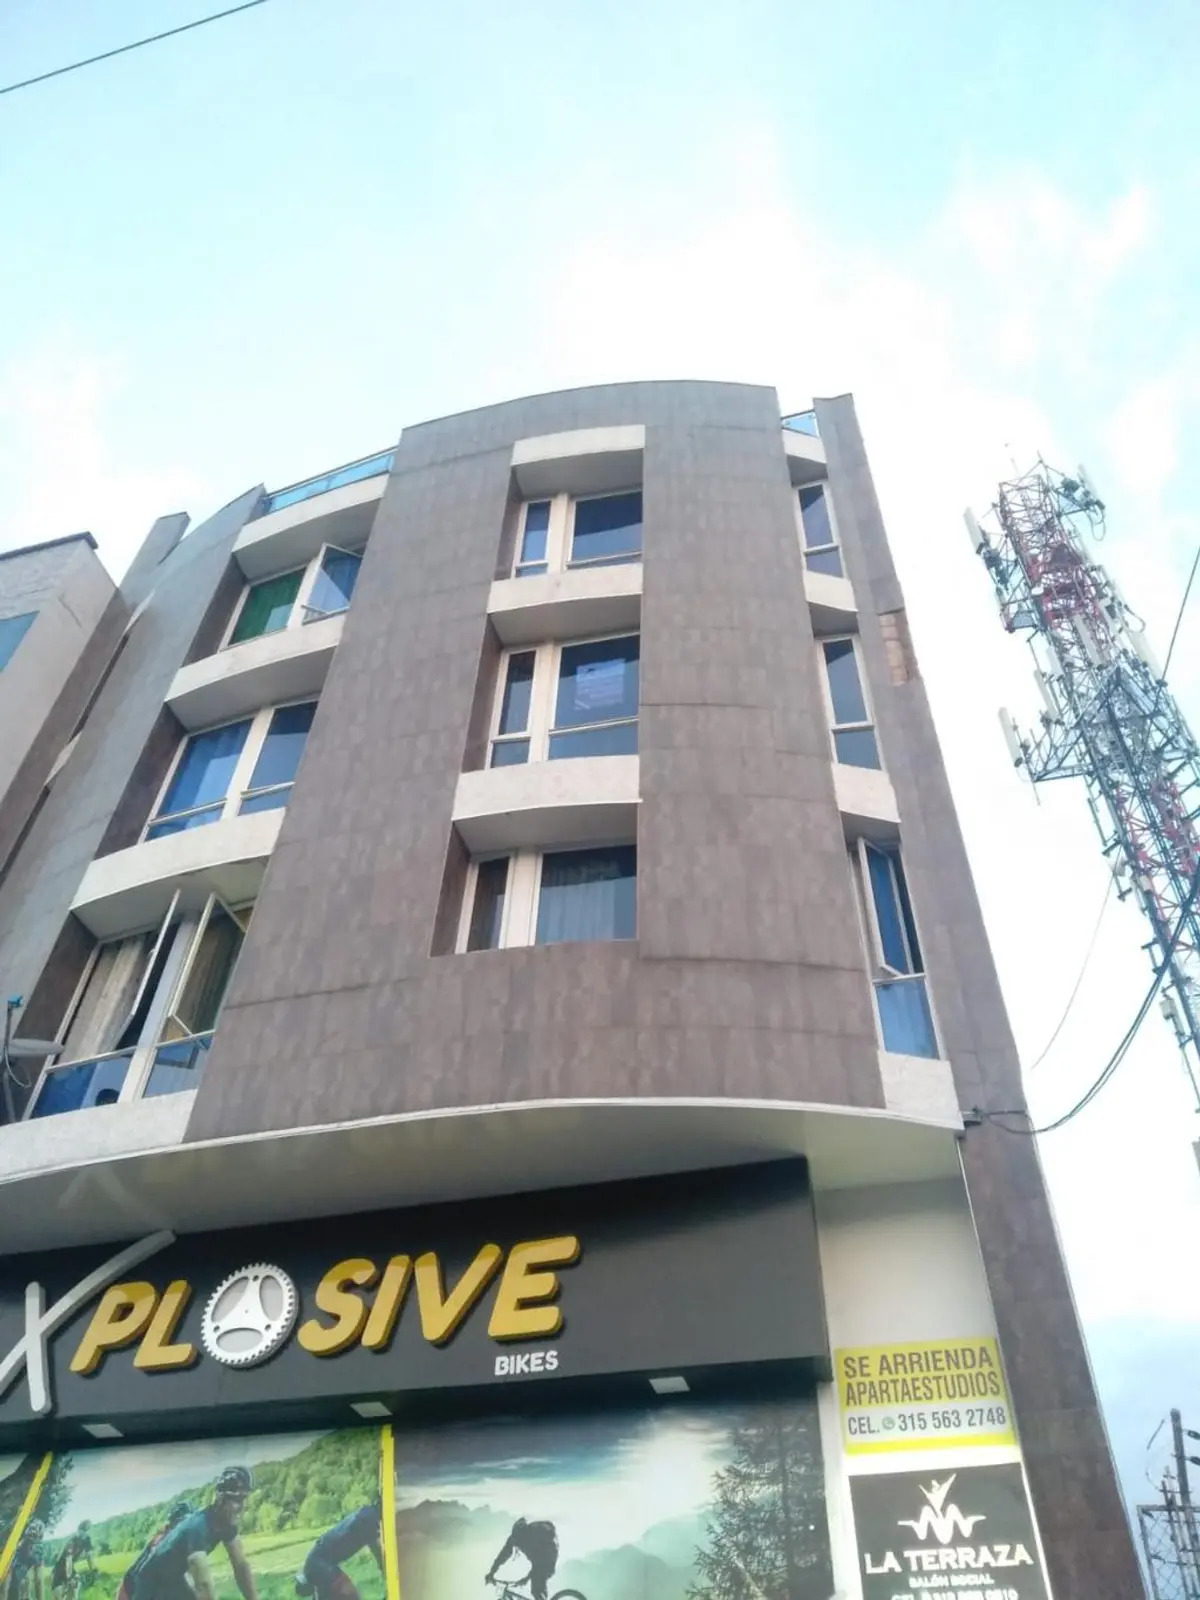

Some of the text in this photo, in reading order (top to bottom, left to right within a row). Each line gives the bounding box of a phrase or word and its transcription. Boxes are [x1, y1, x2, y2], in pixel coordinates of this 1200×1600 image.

[494, 1350, 559, 1376] BIKES
[843, 1346, 993, 1379] SE ARRIENDA
[845, 1371, 1001, 1406] APARTAESTUDIOS
[848, 1406, 1006, 1435] CEL. 315 563 2748
[864, 1543, 1034, 1574] LA TERRAZA
